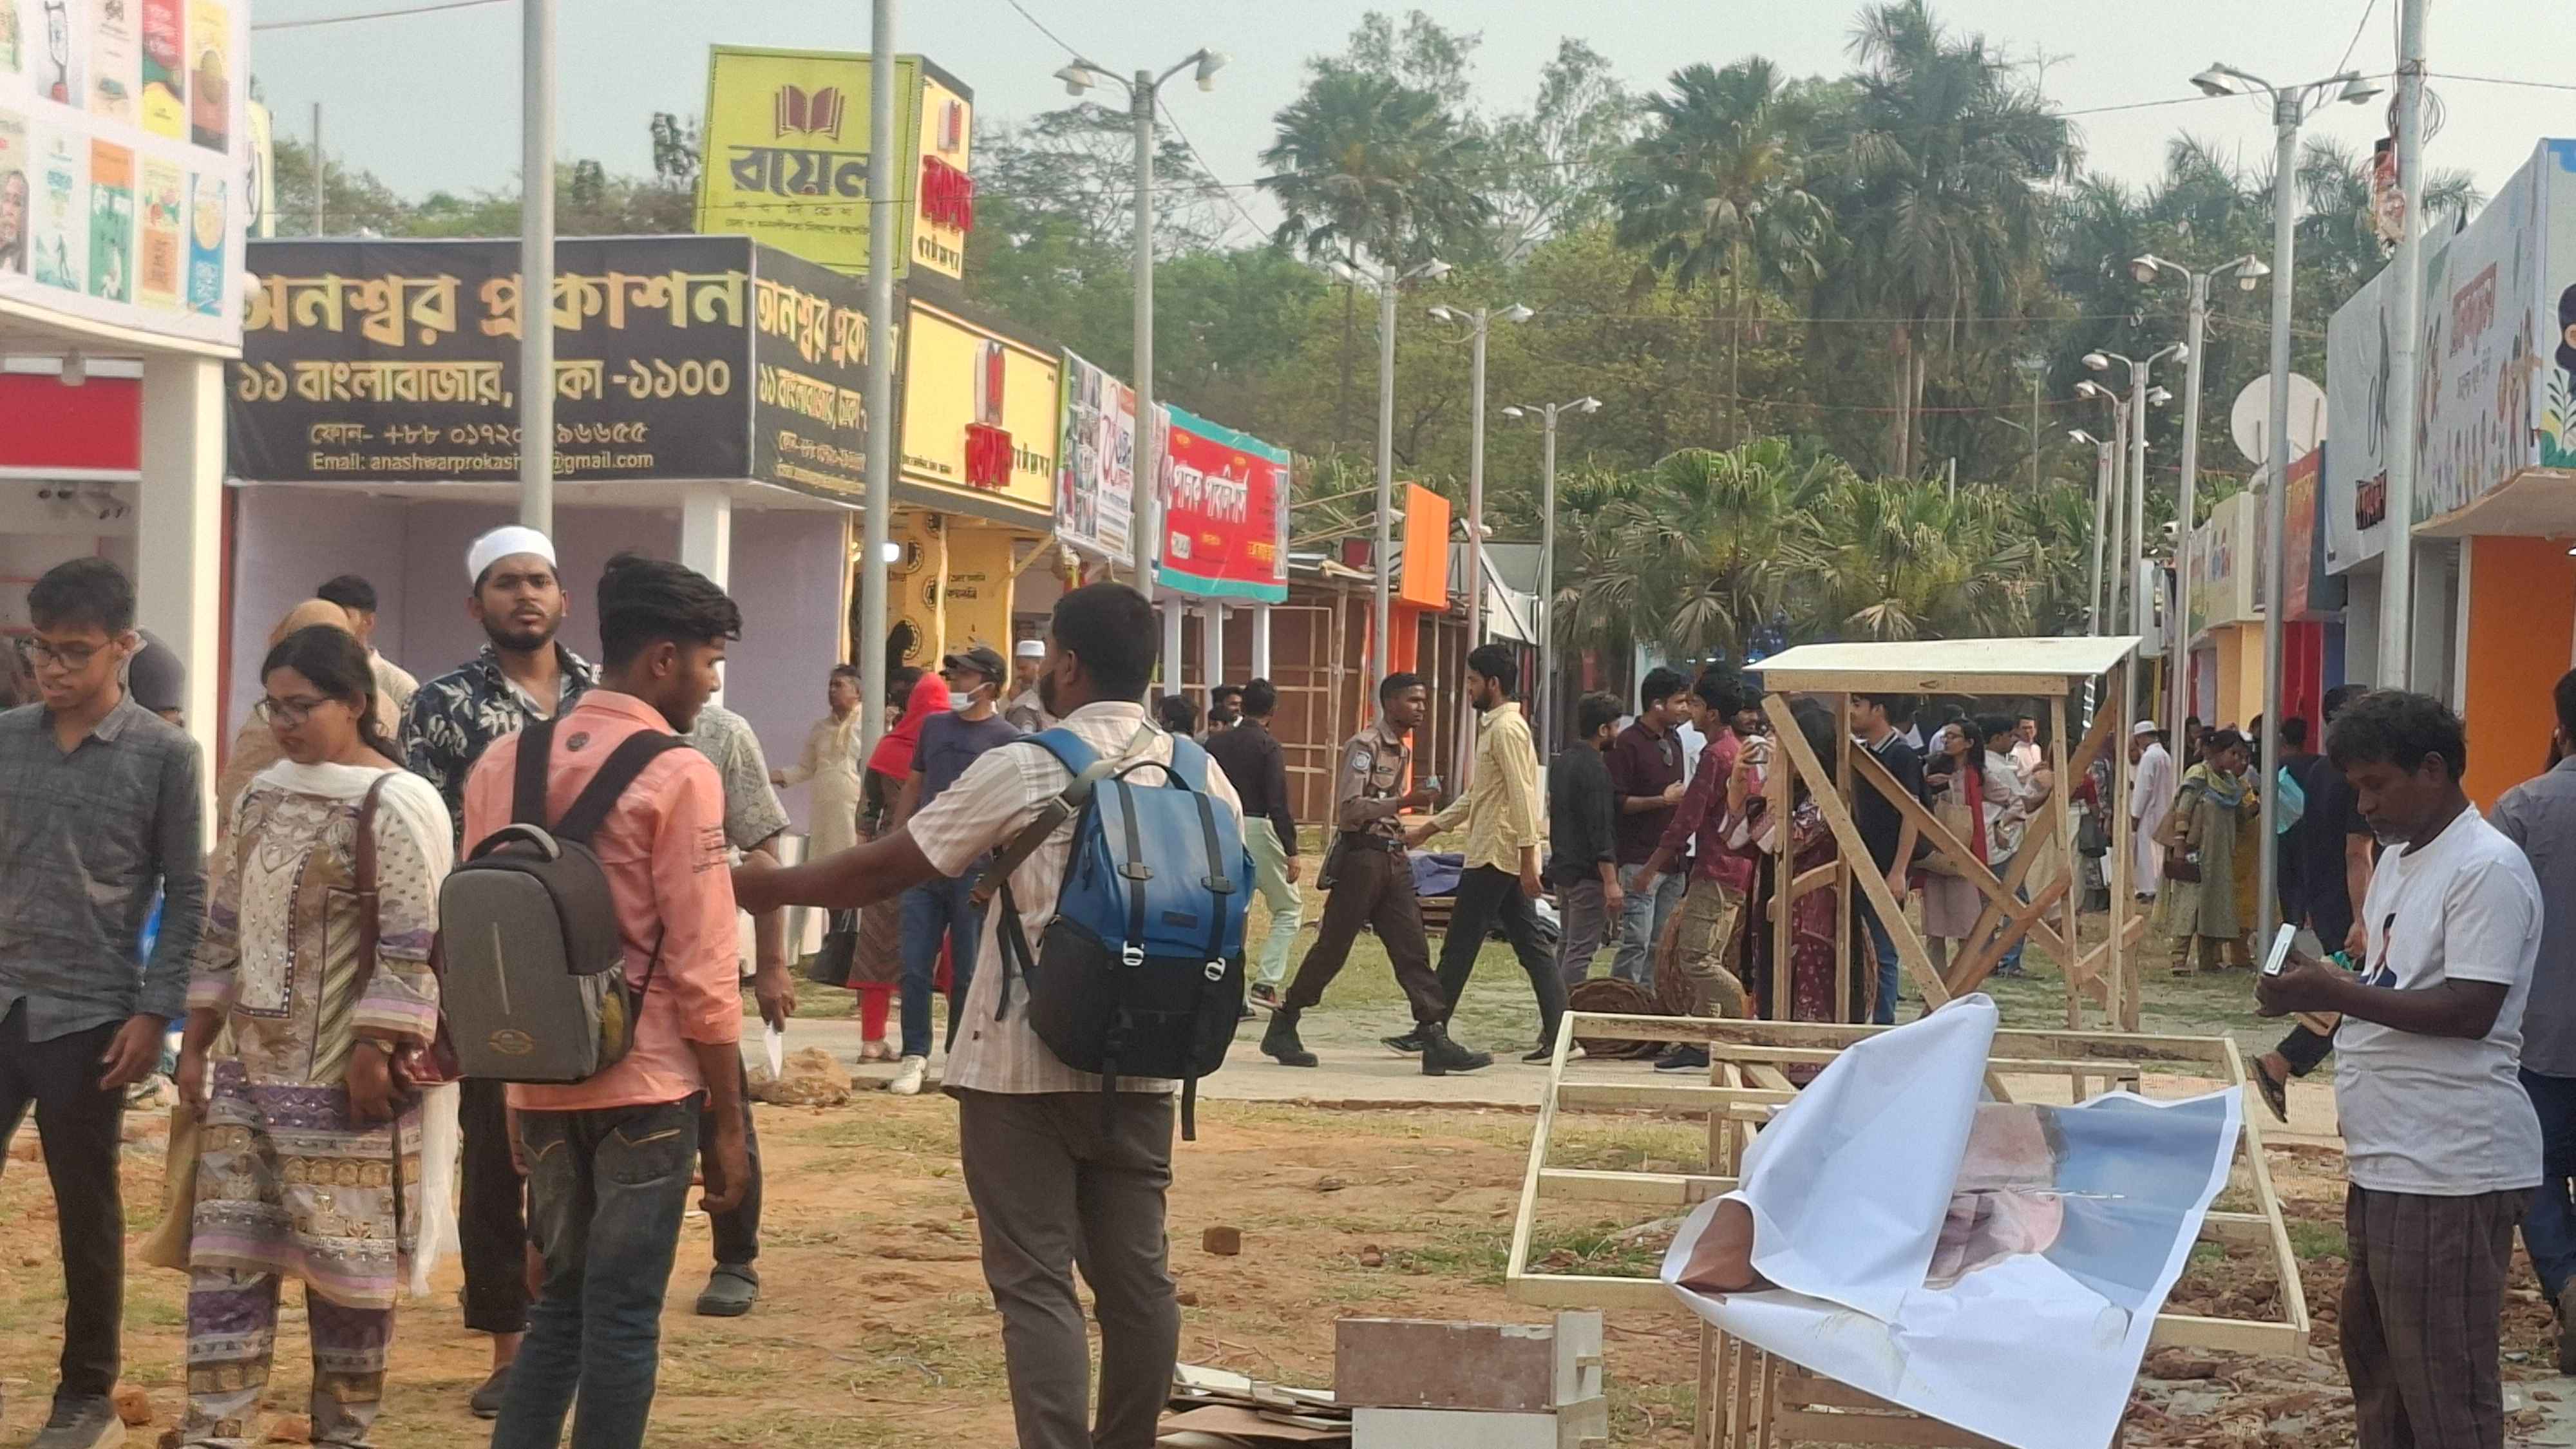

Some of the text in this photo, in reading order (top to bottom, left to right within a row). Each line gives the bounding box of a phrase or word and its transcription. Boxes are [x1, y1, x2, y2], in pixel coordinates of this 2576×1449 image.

[238, 361, 289, 402] ১১
[292, 359, 513, 409] বাংলাবাজার,
[312, 452, 366, 470] Email:
